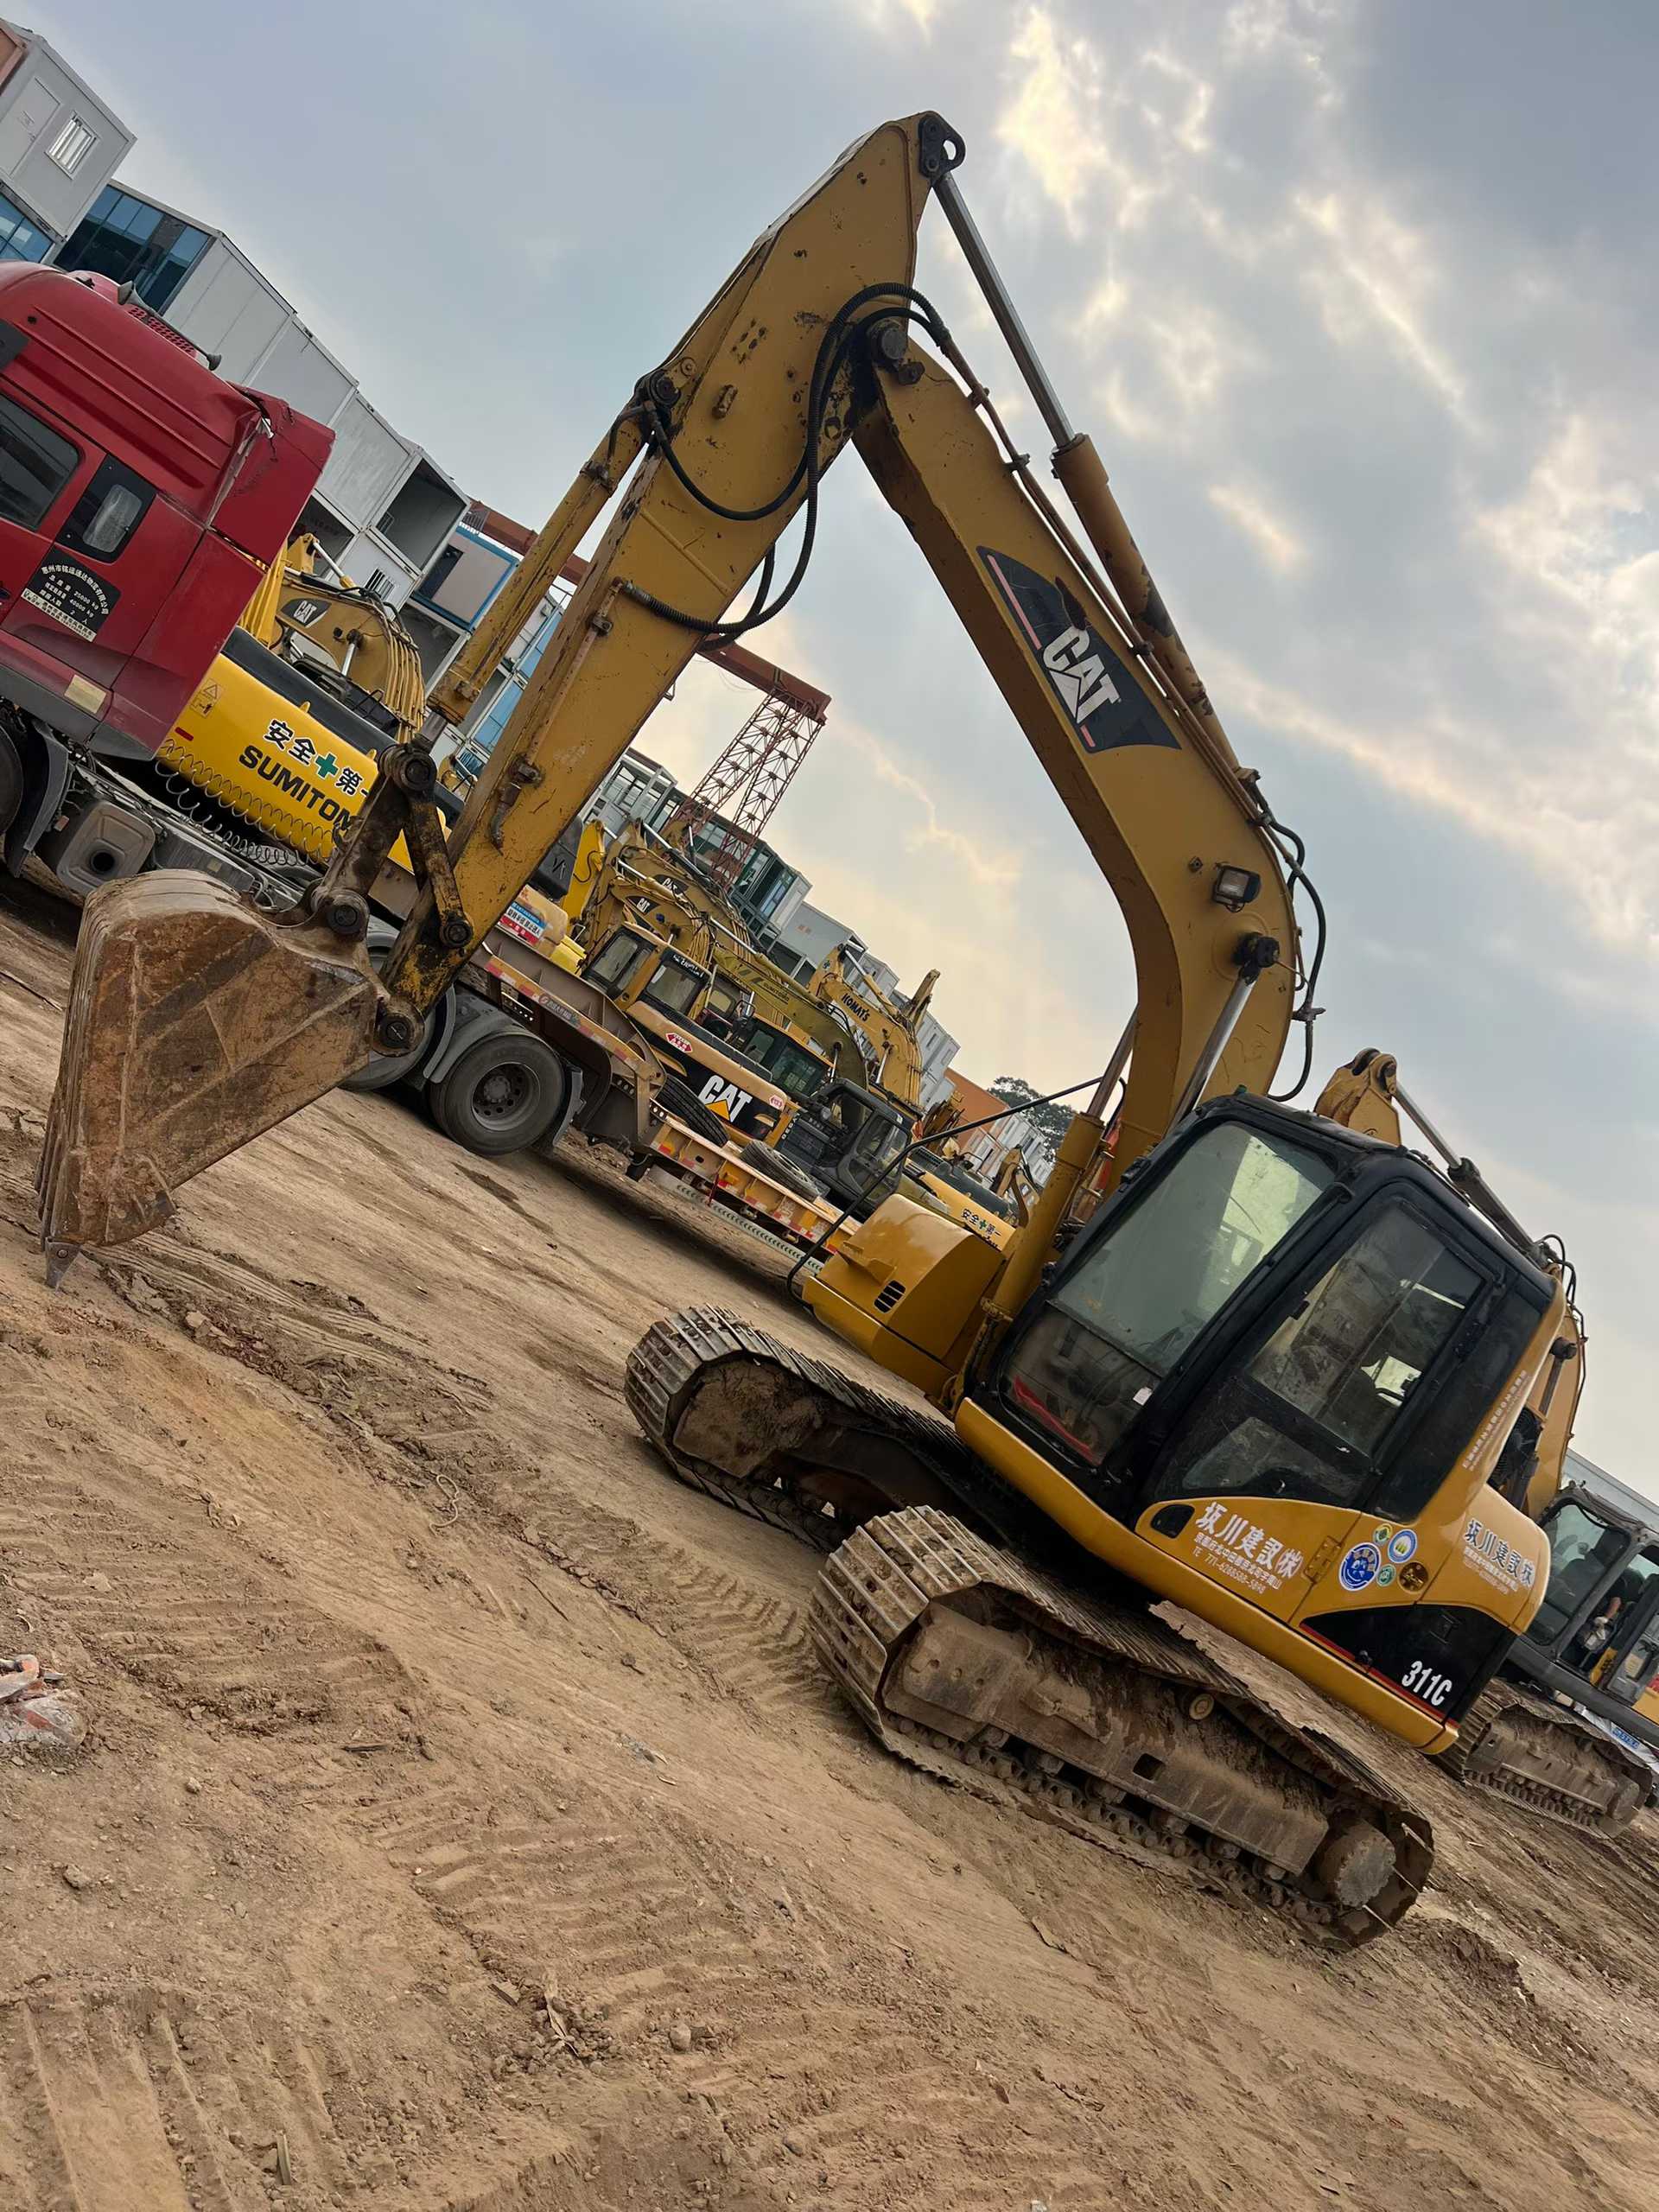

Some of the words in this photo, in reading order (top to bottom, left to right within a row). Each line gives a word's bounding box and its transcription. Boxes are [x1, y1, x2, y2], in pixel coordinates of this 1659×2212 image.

[293, 600, 317, 623] CAT
[1043, 625, 1122, 723] CAT
[264, 719, 317, 766] 安全
[636, 897, 651, 912] CAT
[697, 1075, 753, 1122] CAT
[960, 1207, 981, 1225] 安全
[984, 1223, 1002, 1236] 第一
[1402, 1660, 1452, 1706] 311C
